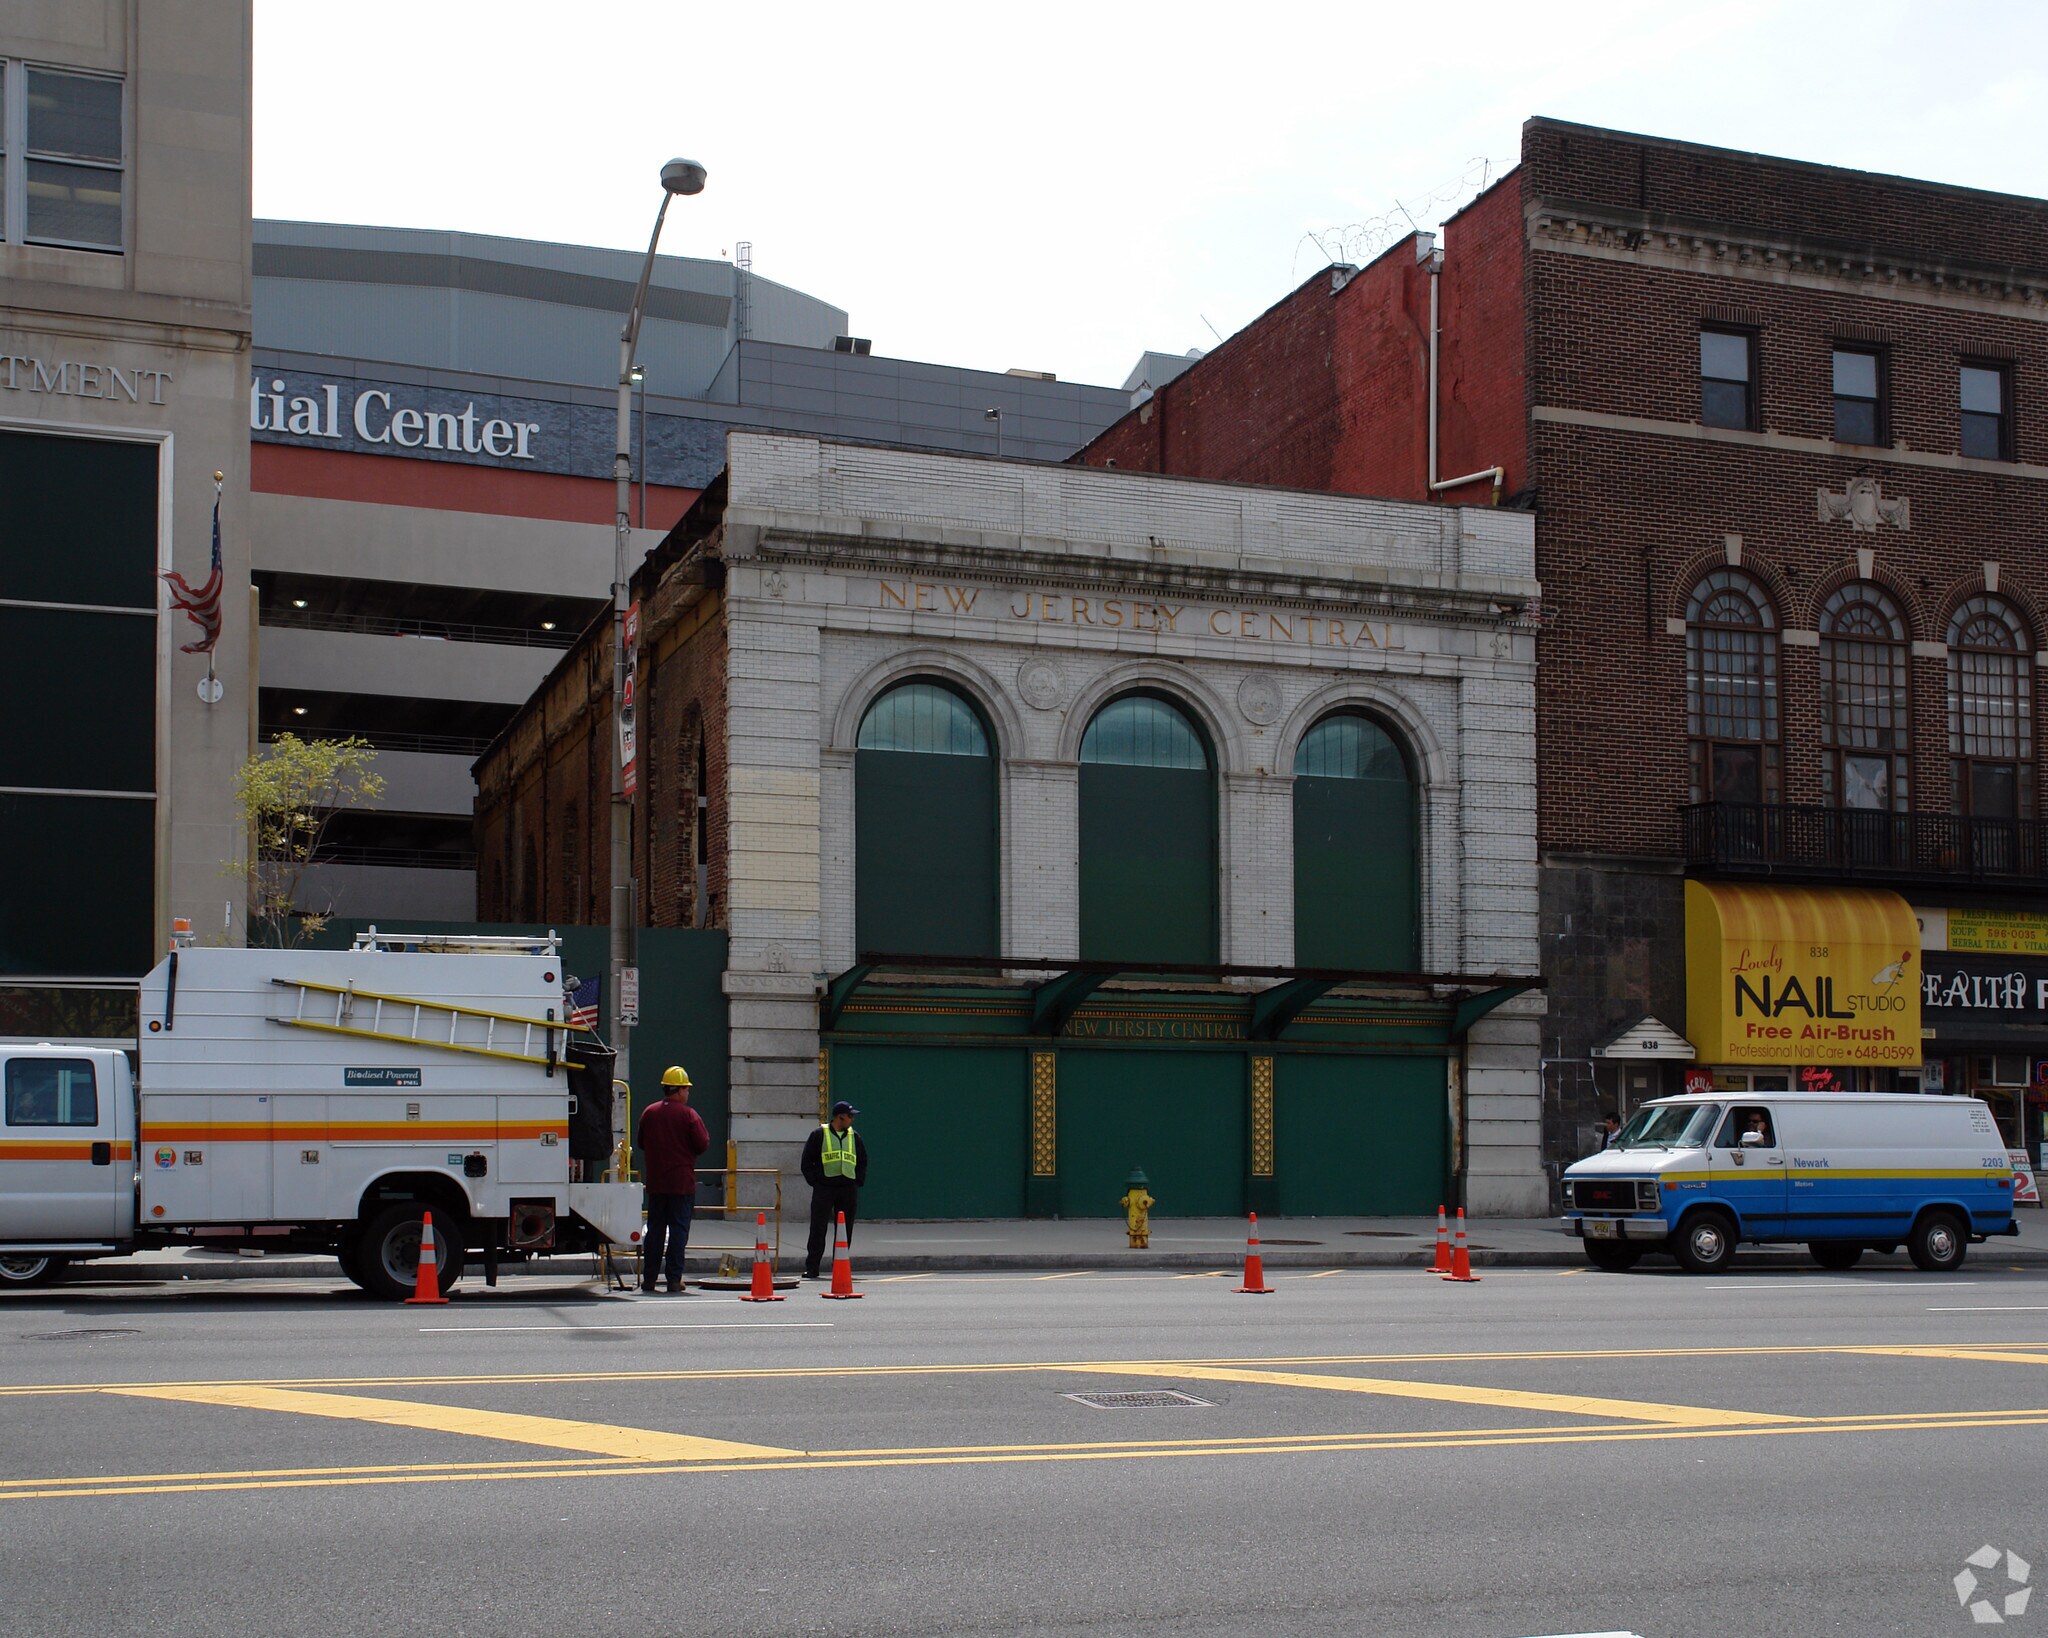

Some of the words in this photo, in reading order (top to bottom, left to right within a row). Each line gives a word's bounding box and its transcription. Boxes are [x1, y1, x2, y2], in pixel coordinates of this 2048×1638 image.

[0, 354, 174, 405] TMENT
[251, 377, 342, 438] tial
[353, 390, 541, 460] Center
[879, 580, 981, 613] NEW
[1010, 593, 1184, 632] JERSEY
[1210, 608, 1406, 650] CENTRAL
[1951, 927, 1977, 936] SOUPS
[1952, 938, 1982, 948] HERBAL
[1986, 940, 2008, 949] TEAS
[1730, 944, 1783, 973] Lovely
[1810, 947, 1829, 958] 838
[625, 970, 635, 980] NO
[1735, 974, 1855, 1019] NAIL
[1847, 995, 1906, 1012] STUDIO
[1920, 970, 2026, 1009] EALTH
[1063, 1019, 1099, 1036] NEW
[1105, 1020, 1168, 1038] JERSEY
[1171, 1022, 1247, 1040] CENTRAL
[1746, 1023, 1793, 1039] Free
[1800, 1024, 1896, 1041] Air-Brush
[1642, 1041, 1659, 1050] 838
[1729, 1043, 1793, 1059] Professional
[1794, 1044, 1815, 1059] Nail
[1816, 1045, 1844, 1059] Care
[1854, 1045, 1915, 1060] 648-0599
[347, 1070, 384, 1079] Biodiesel
[385, 1071, 419, 1079] Powered
[1793, 1157, 1830, 1168] Newark
[1981, 1158, 2004, 1168] 2203
